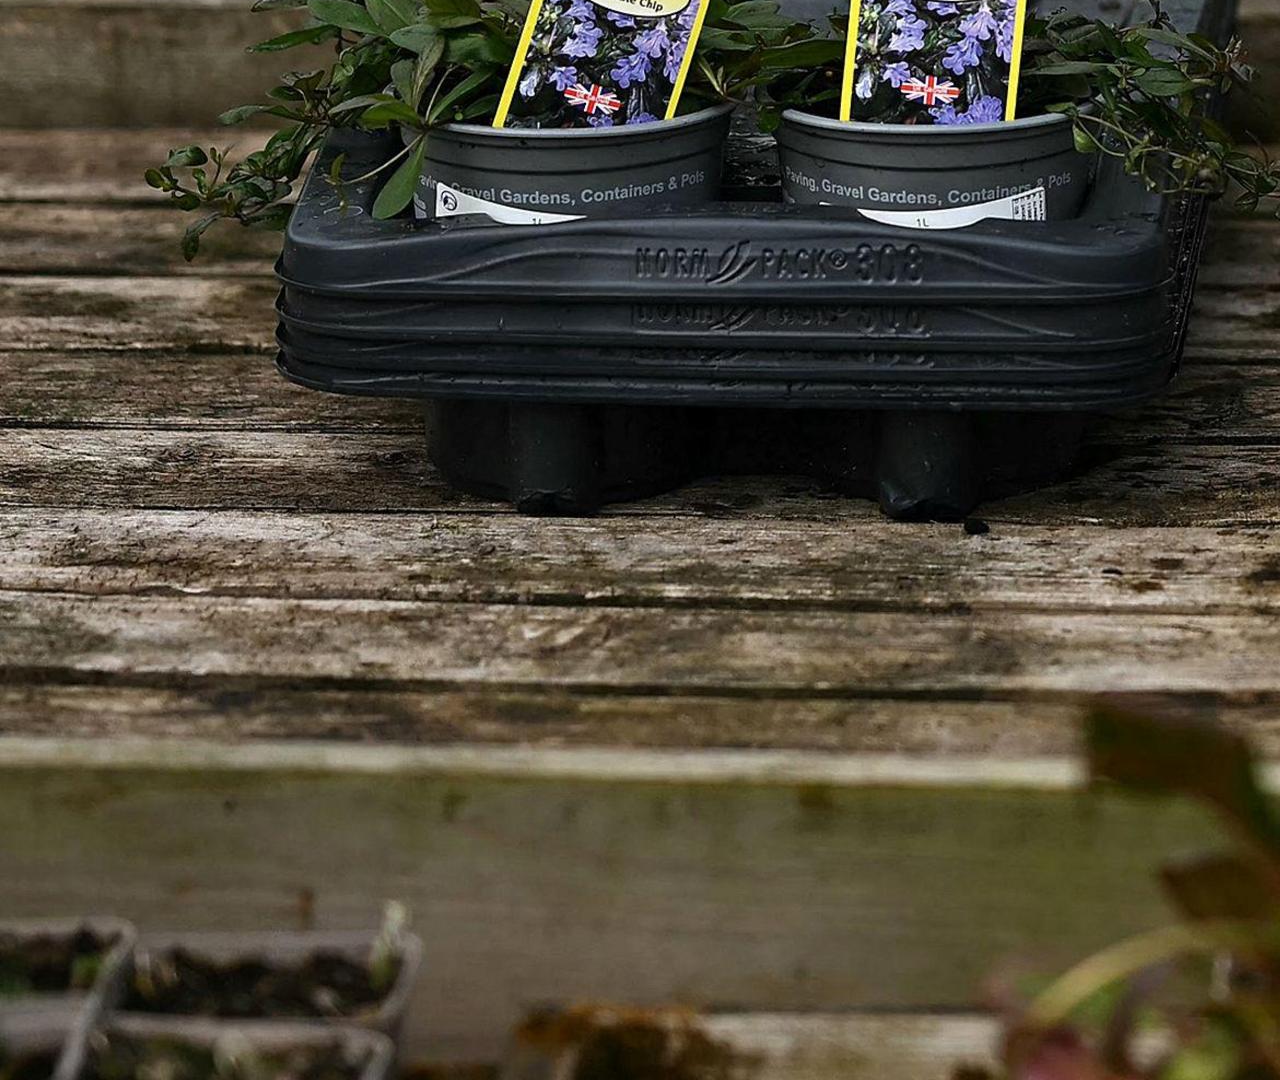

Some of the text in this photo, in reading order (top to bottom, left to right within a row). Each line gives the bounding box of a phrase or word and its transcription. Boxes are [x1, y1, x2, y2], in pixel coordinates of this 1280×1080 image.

[500, 189, 576, 206] Gardens,
[580, 181, 664, 203] Containers
[667, 176, 678, 191] &
[681, 169, 705, 189] Pots
[821, 179, 864, 200] Gravel
[868, 187, 943, 206] Gardens,
[1048, 172, 1072, 189] Pots
[635, 247, 711, 279] NORM
